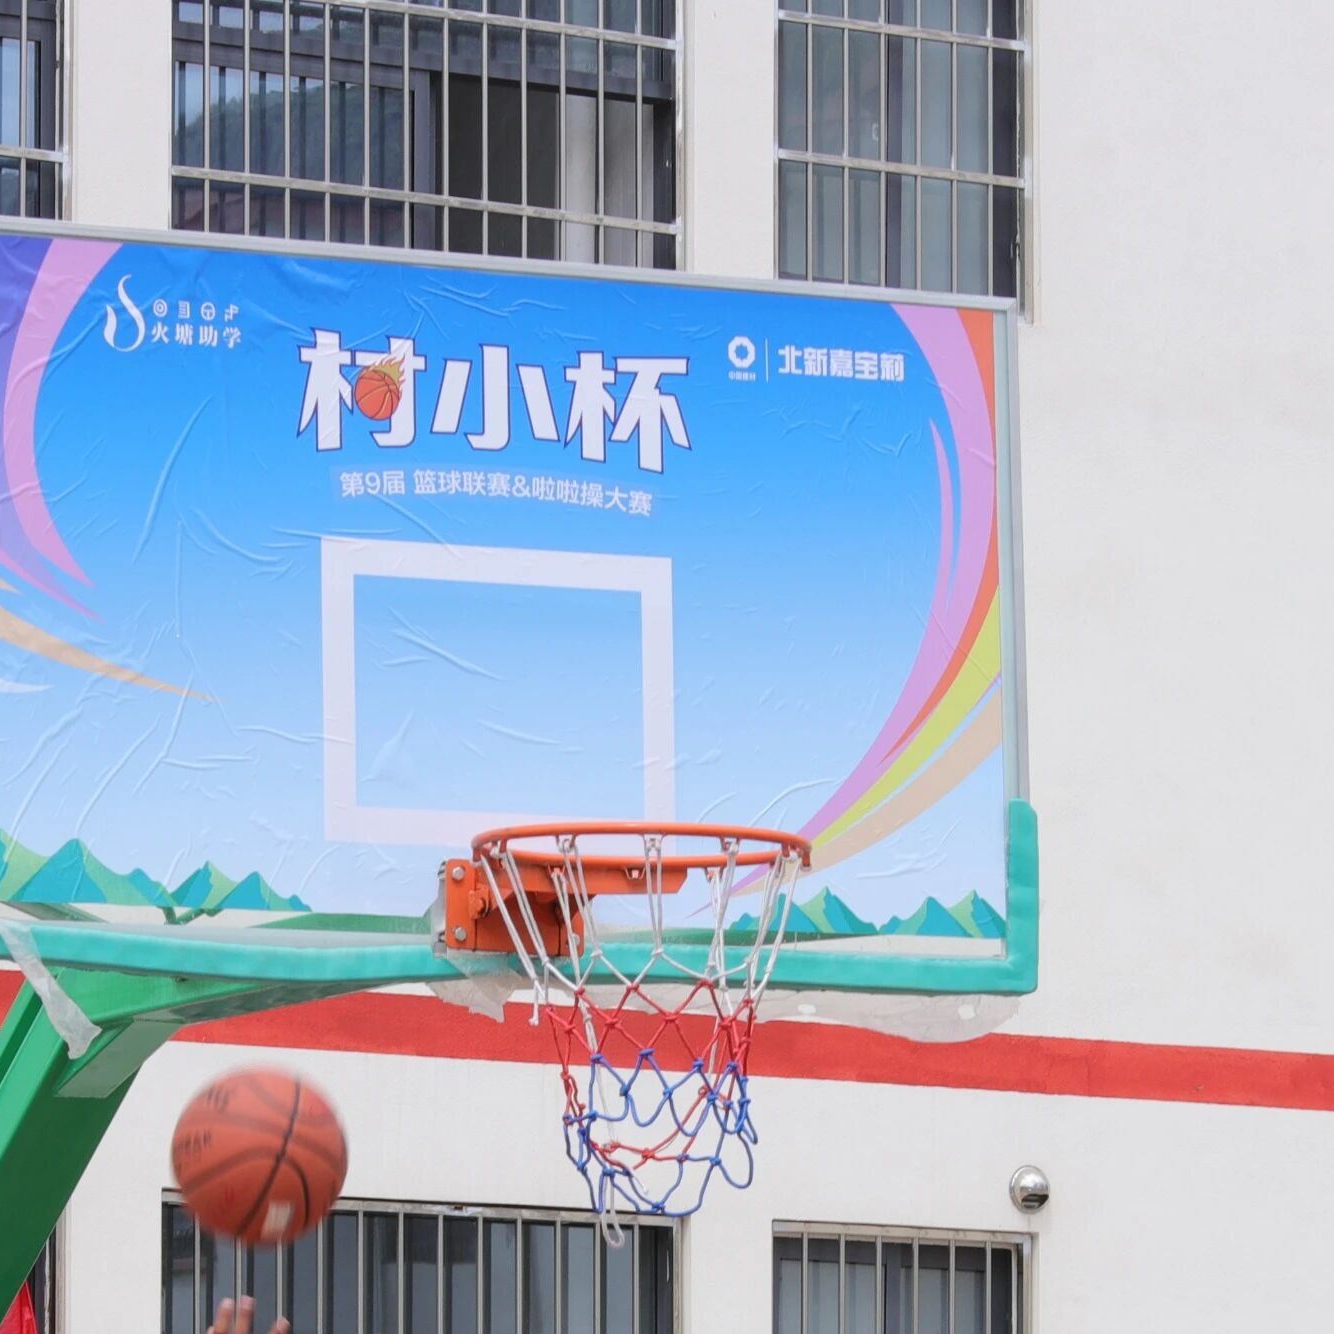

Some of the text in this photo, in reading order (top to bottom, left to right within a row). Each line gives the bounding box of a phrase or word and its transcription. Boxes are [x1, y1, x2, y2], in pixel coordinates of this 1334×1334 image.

[151, 322, 242, 348] 火塘助学
[778, 345, 905, 382] 北新嘉宝莉
[297, 328, 692, 474] 村小杯
[339, 469, 653, 517] 第9届 篮球联赛&啦啦操大赛
